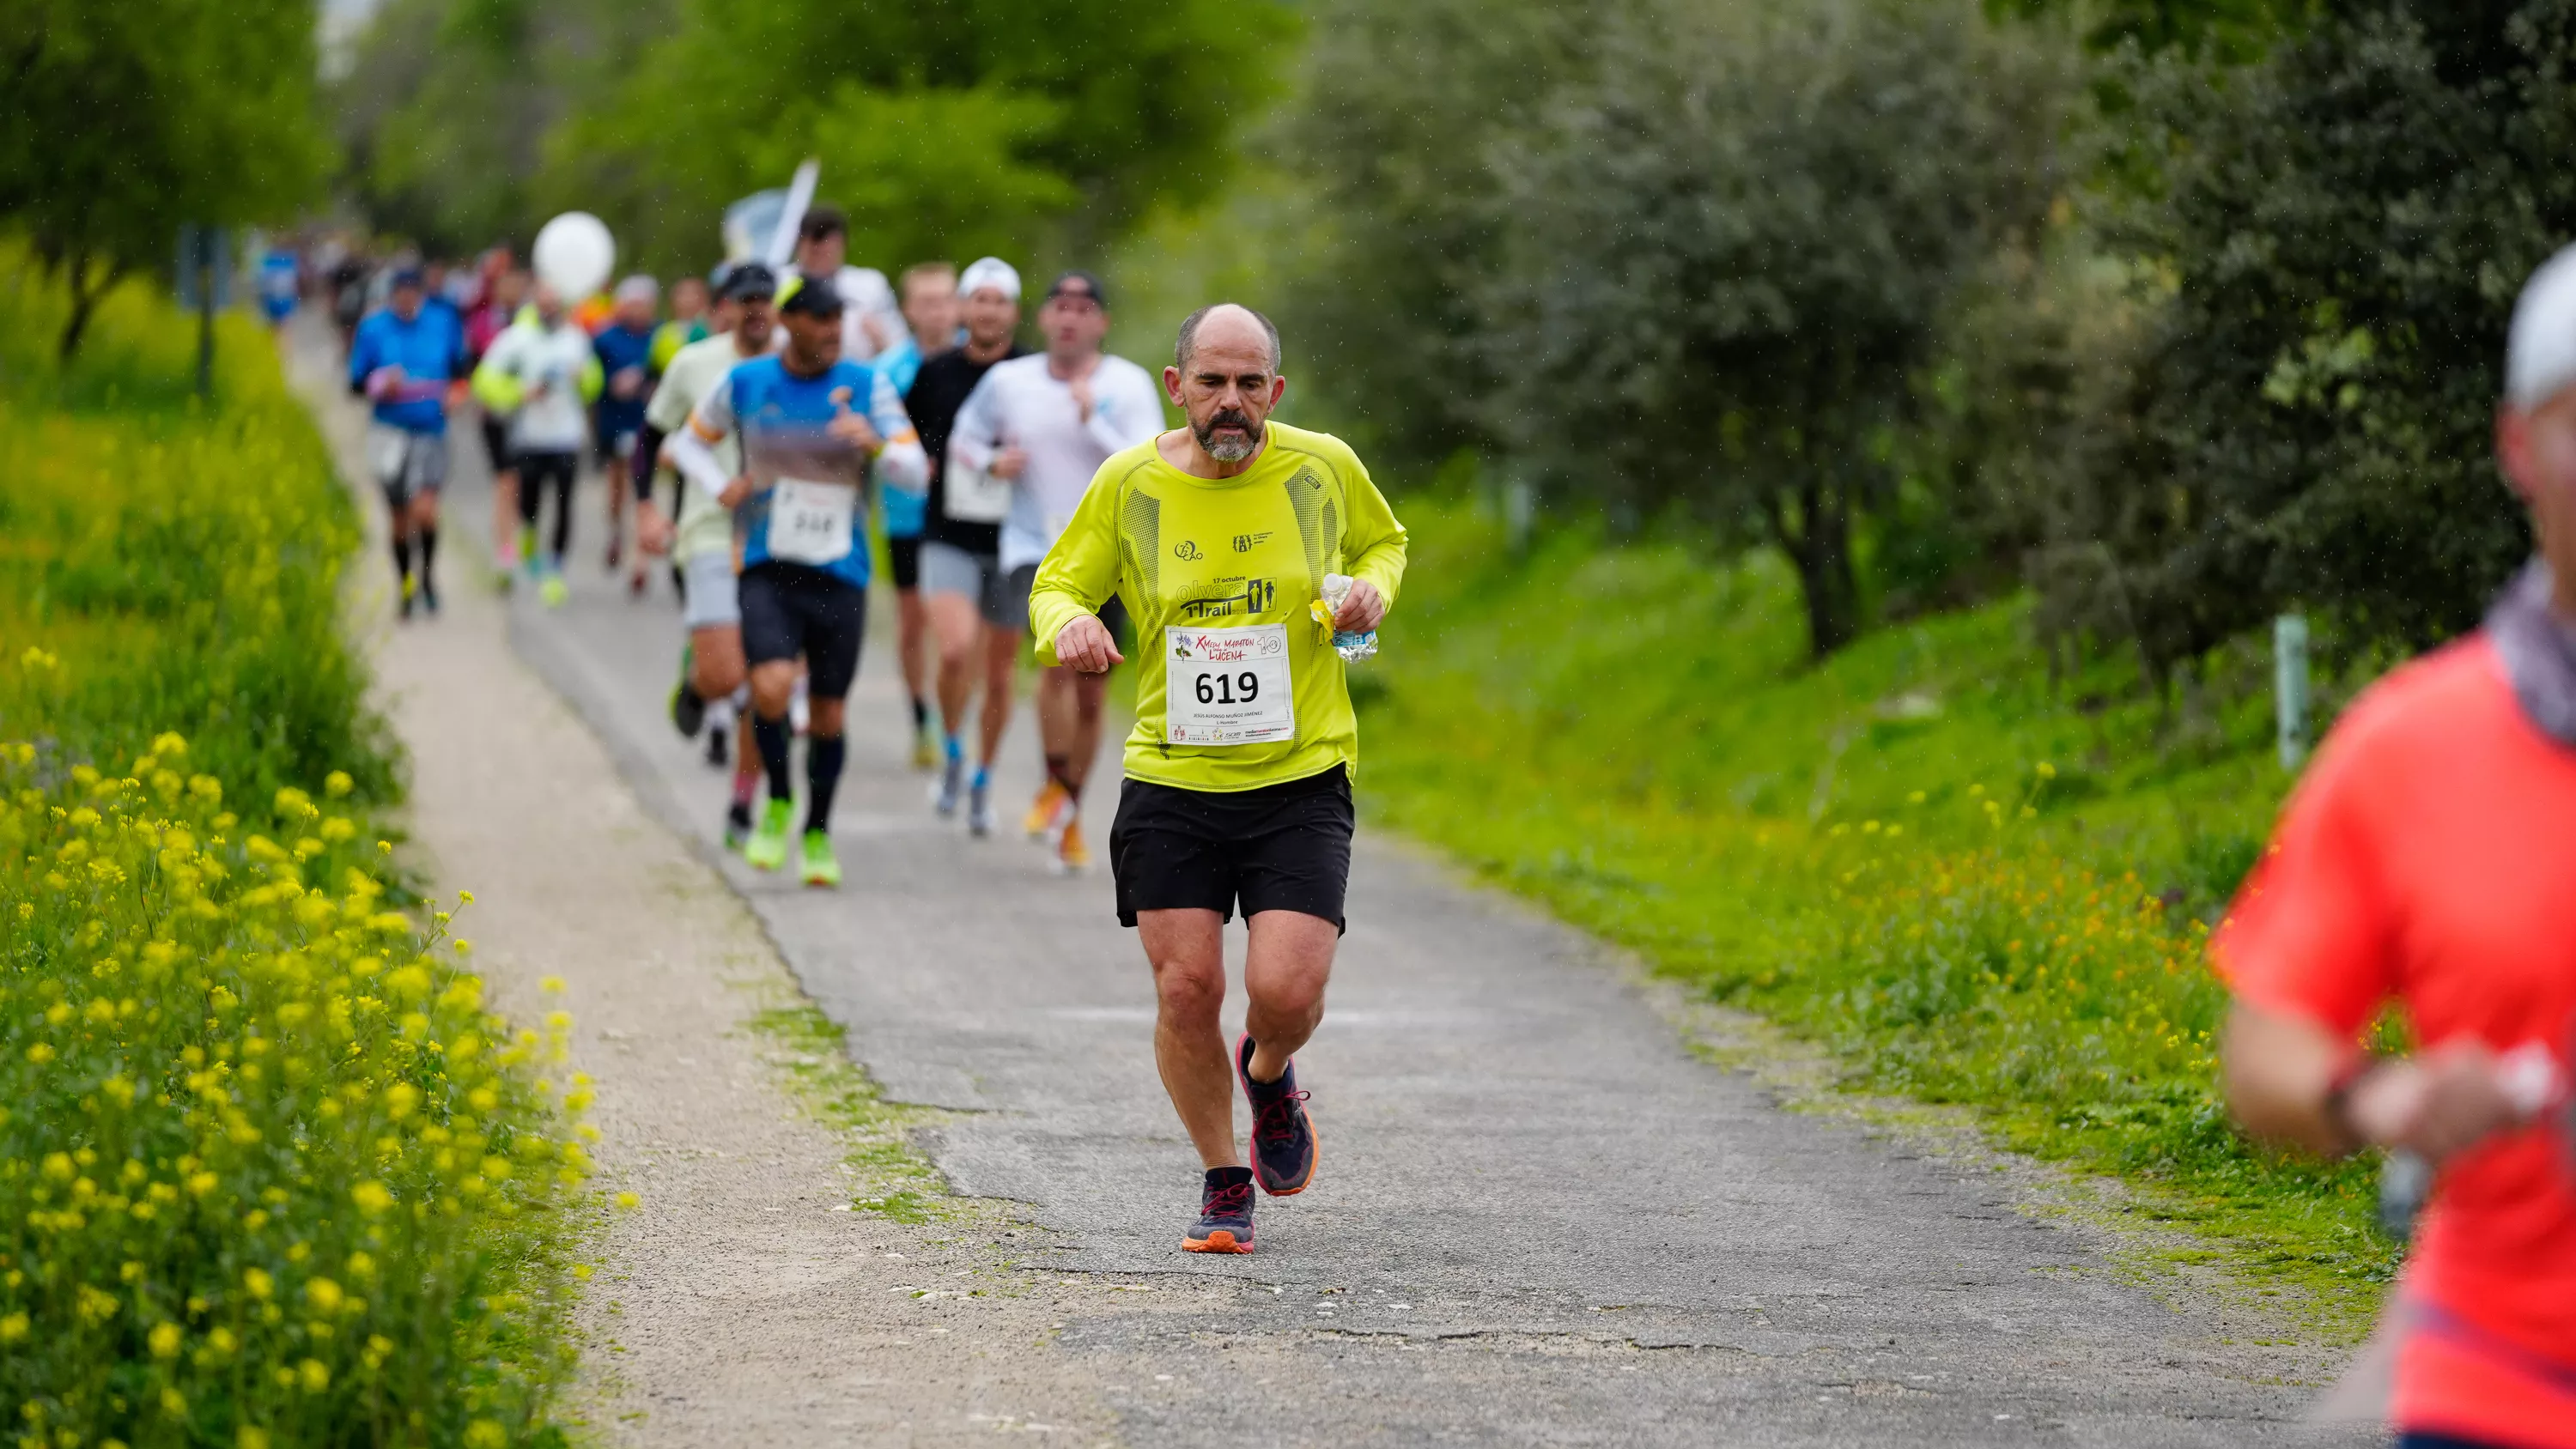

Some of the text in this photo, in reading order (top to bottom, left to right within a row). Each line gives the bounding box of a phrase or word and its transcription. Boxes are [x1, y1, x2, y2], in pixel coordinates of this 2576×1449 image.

[1176, 579, 1245, 603] olvera
[1199, 601, 1231, 617] Trail
[1209, 650, 1248, 661] LUCENA
[1195, 671, 1259, 704] 619
